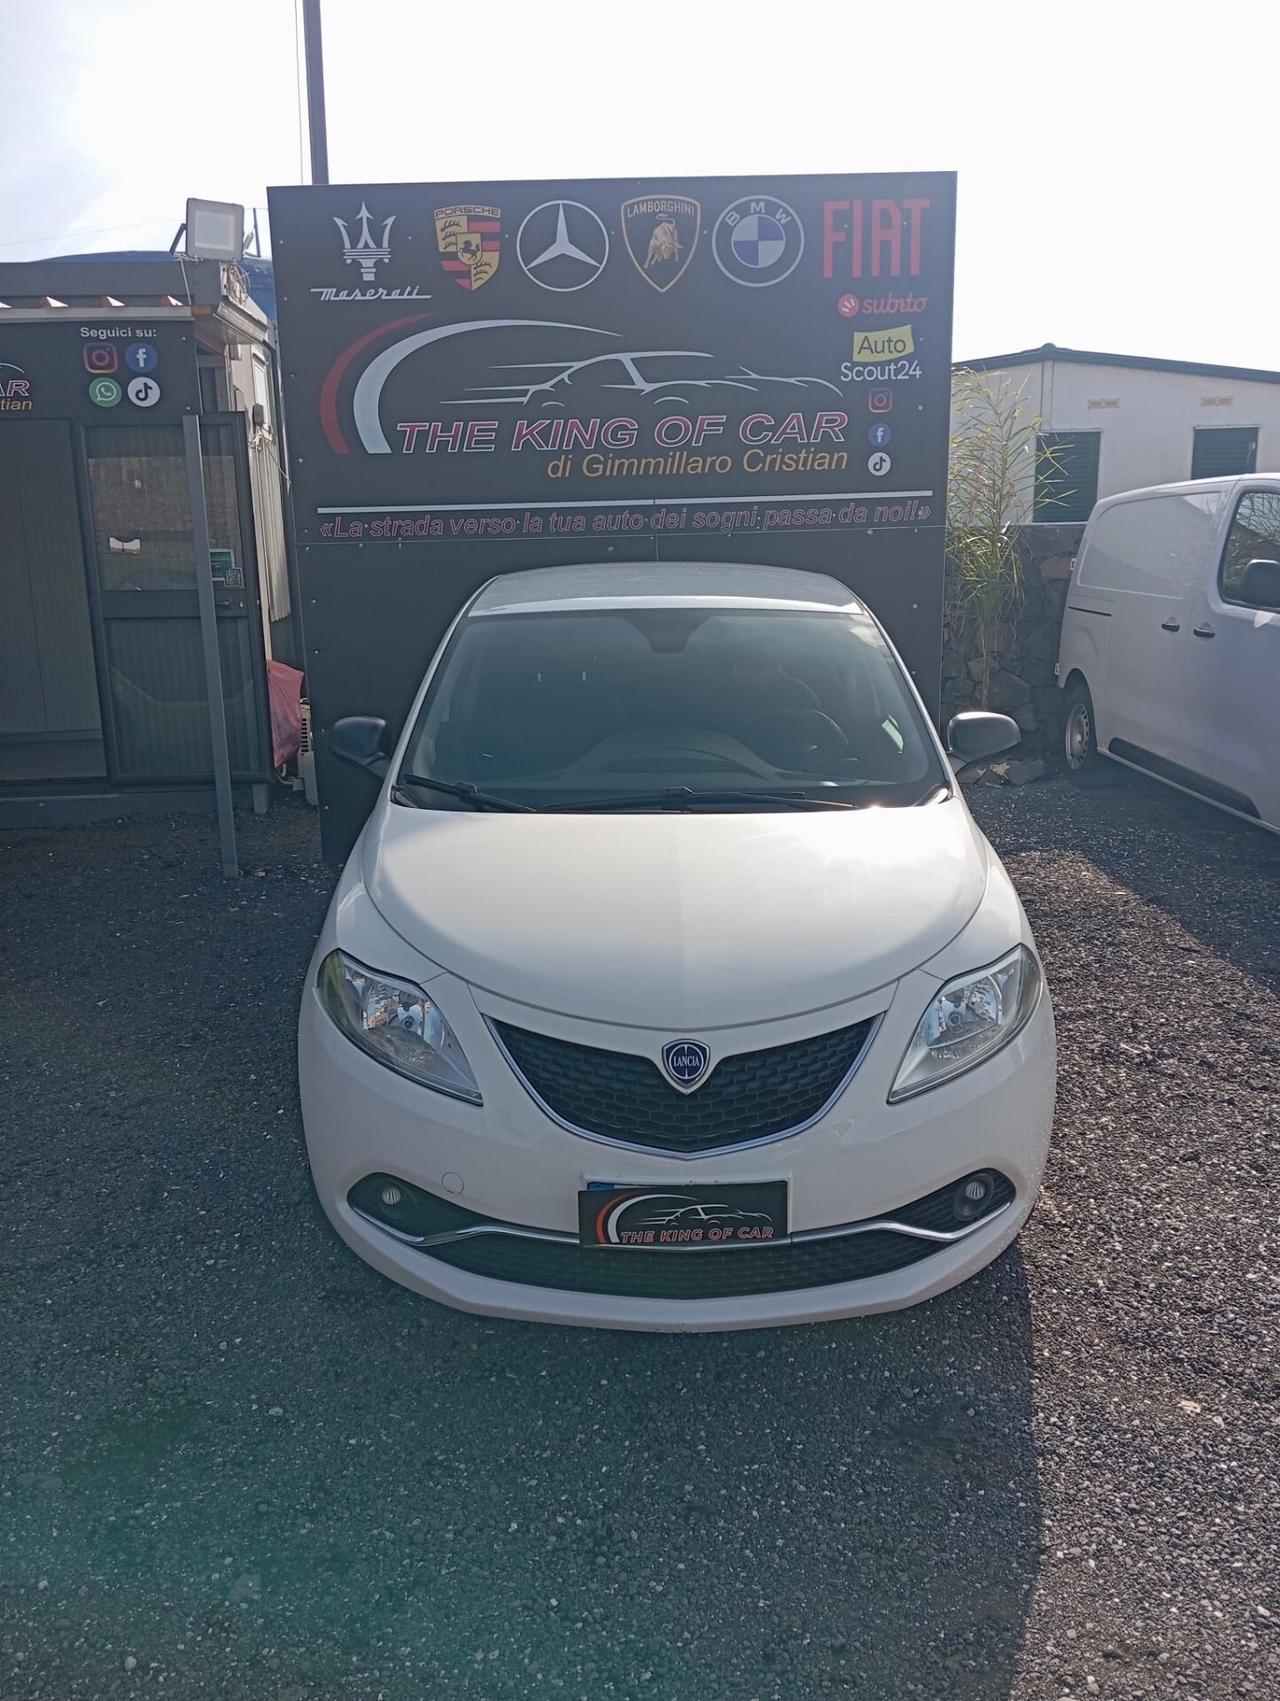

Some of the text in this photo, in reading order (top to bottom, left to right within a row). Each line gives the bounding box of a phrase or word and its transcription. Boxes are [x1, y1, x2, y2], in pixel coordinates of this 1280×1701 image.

[436, 206, 500, 218] PORSCHE
[626, 199, 695, 218] LAMBORGHINI
[725, 201, 791, 226] BMW
[823, 198, 931, 279] FIAT
[863, 292, 928, 314] subito
[80, 326, 157, 340] Seguici su:
[857, 335, 907, 355] Auto
[840, 360, 923, 382] Scout24
[397, 411, 849, 454] THE KING OF CAR
[547, 447, 849, 478] di Gimmillaro Cristian
[370, 514, 444, 537] strada
[450, 516, 517, 535] verso
[522, 512, 543, 533] la
[549, 512, 586, 533] tua
[592, 510, 645, 531] auto
[650, 506, 688, 530] dei
[692, 506, 758, 532] sogni
[762, 505, 834, 532] passa
[838, 502, 868, 524] da
[673, 1054, 701, 1068] LANCIA
[620, 1226, 774, 1244] THE KING OF CAR
